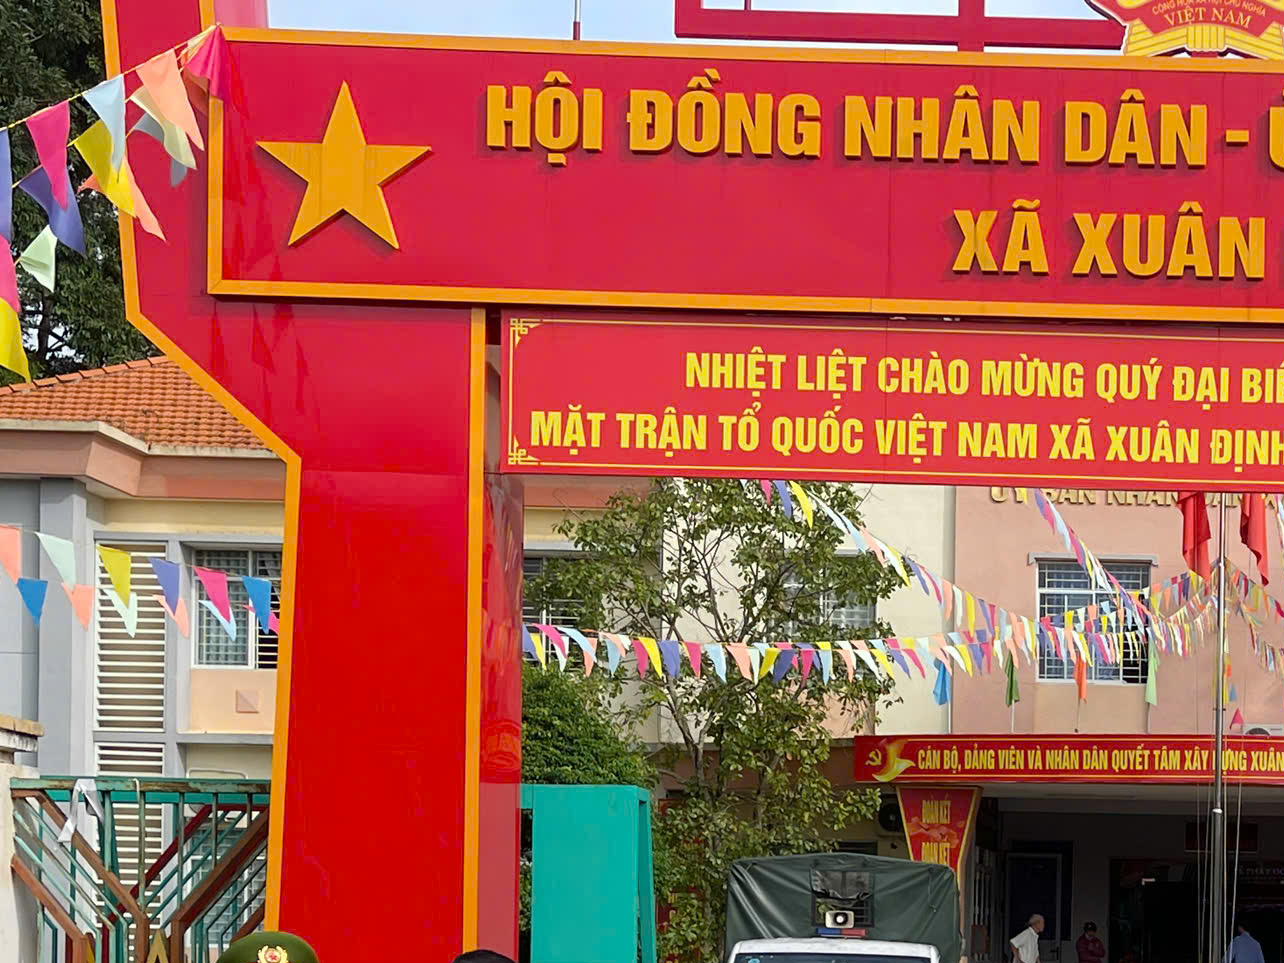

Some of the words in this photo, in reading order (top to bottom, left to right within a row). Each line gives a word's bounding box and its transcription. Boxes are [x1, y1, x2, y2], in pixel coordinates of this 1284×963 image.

[1163, 5, 1207, 26] VIỆT
[1211, 7, 1252, 28] NAM
[487, 71, 602, 163] HỘI
[627, 68, 820, 156] ĐỒNG
[845, 86, 1039, 161] NHÂN
[1065, 90, 1206, 166] DÂN
[1226, 130, 1249, 143] -
[953, 199, 1049, 273] XÃ
[1073, 202, 1265, 278] XUÂN
[686, 345, 786, 397] NHIỆT
[797, 348, 867, 399] LIỆT
[877, 351, 969, 395] CHÀO
[981, 353, 1084, 398] MỪNG
[1095, 357, 1163, 403] QUÝ
[1172, 366, 1229, 410] ĐẠI
[529, 404, 607, 457] MẶT
[615, 407, 707, 457] TRẬN
[718, 402, 761, 452] TỔ
[771, 405, 863, 457] QUỐC
[875, 412, 948, 465] VIỆT
[958, 421, 1038, 459] NAM
[1049, 417, 1095, 461] XÃ
[1105, 420, 1199, 465] XUÂN
[918, 745, 940, 770] CÁN
[943, 745, 961, 774] BỘ,
[964, 743, 995, 770] ĐẢNG
[998, 745, 1024, 770] VIÊN
[1027, 745, 1042, 770] VÀ
[1045, 745, 1080, 770] NHÂN
[1083, 745, 1108, 770] DÂN
[1111, 743, 1150, 772] QUYẾT
[1153, 745, 1181, 770] TÂM
[1184, 745, 1209, 770] XÂY
[1213, 749, 1247, 775] ỰNG
[1250, 747, 1284, 772] XUÂN
